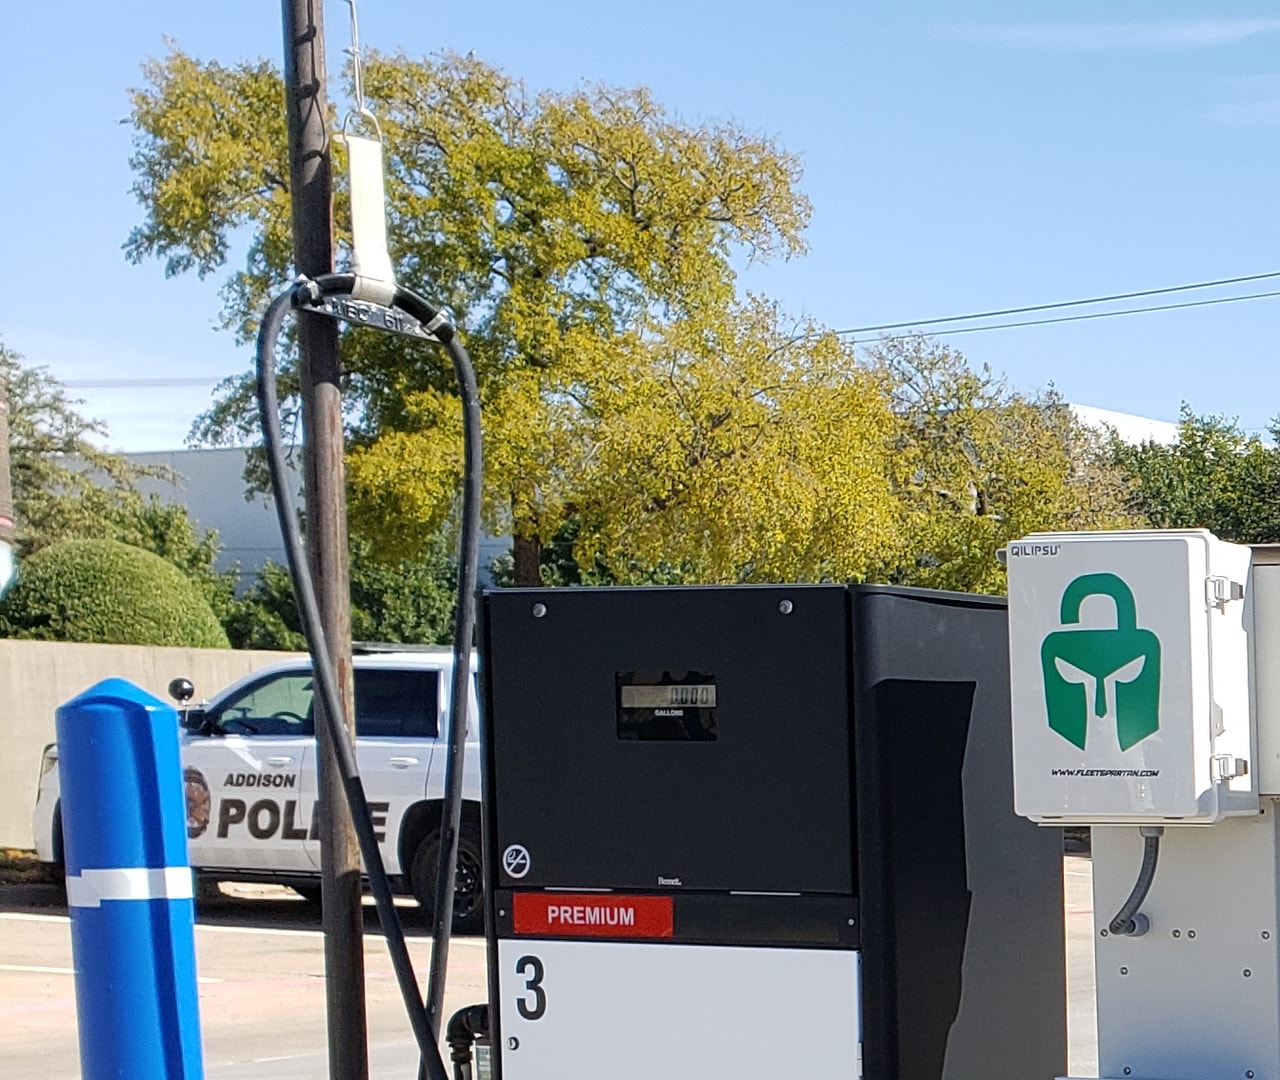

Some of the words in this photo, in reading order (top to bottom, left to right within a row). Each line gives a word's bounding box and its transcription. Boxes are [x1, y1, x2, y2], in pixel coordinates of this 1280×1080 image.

[1011, 546, 1058, 557] QILIPSU
[224, 773, 296, 787] ADDISON
[548, 906, 634, 926] PREMIUM
[516, 955, 547, 1020] 3
